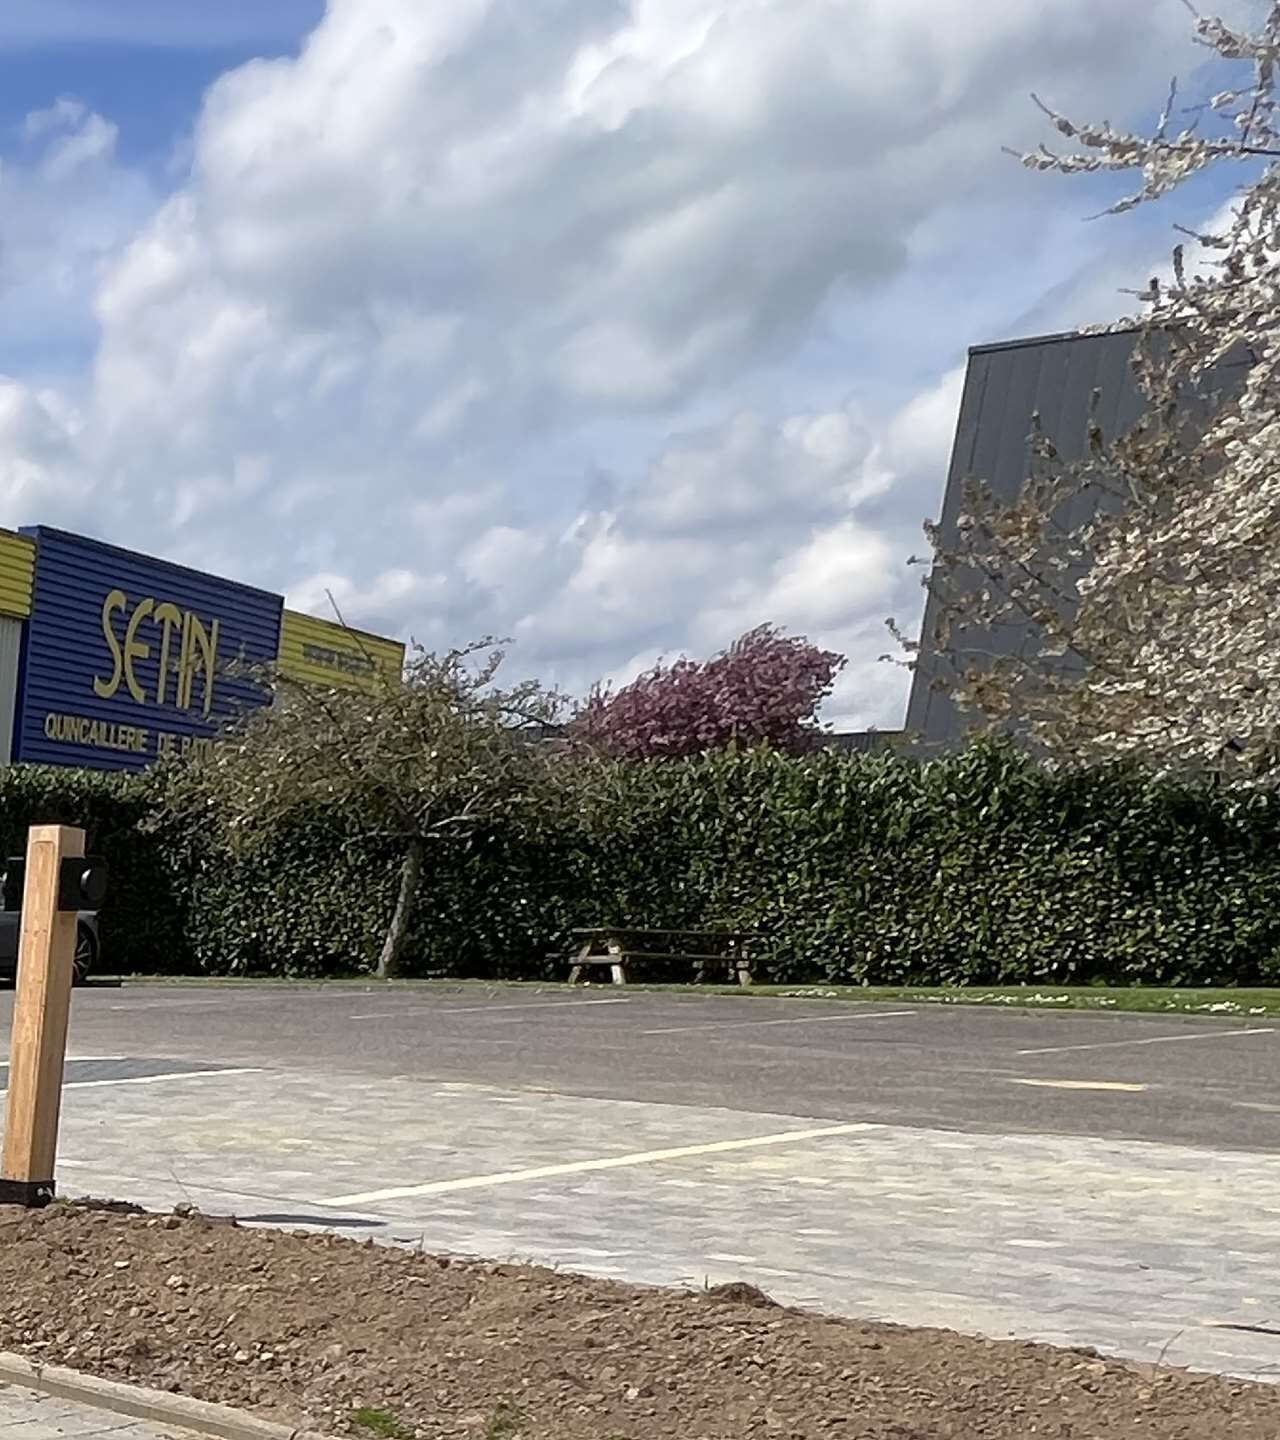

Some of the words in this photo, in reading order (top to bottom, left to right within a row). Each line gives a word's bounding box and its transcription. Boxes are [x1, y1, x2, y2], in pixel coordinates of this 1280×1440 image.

[94, 590, 219, 717] SETIN
[44, 713, 149, 752] QUINCAILLERIE
[157, 732, 176, 756] DE
